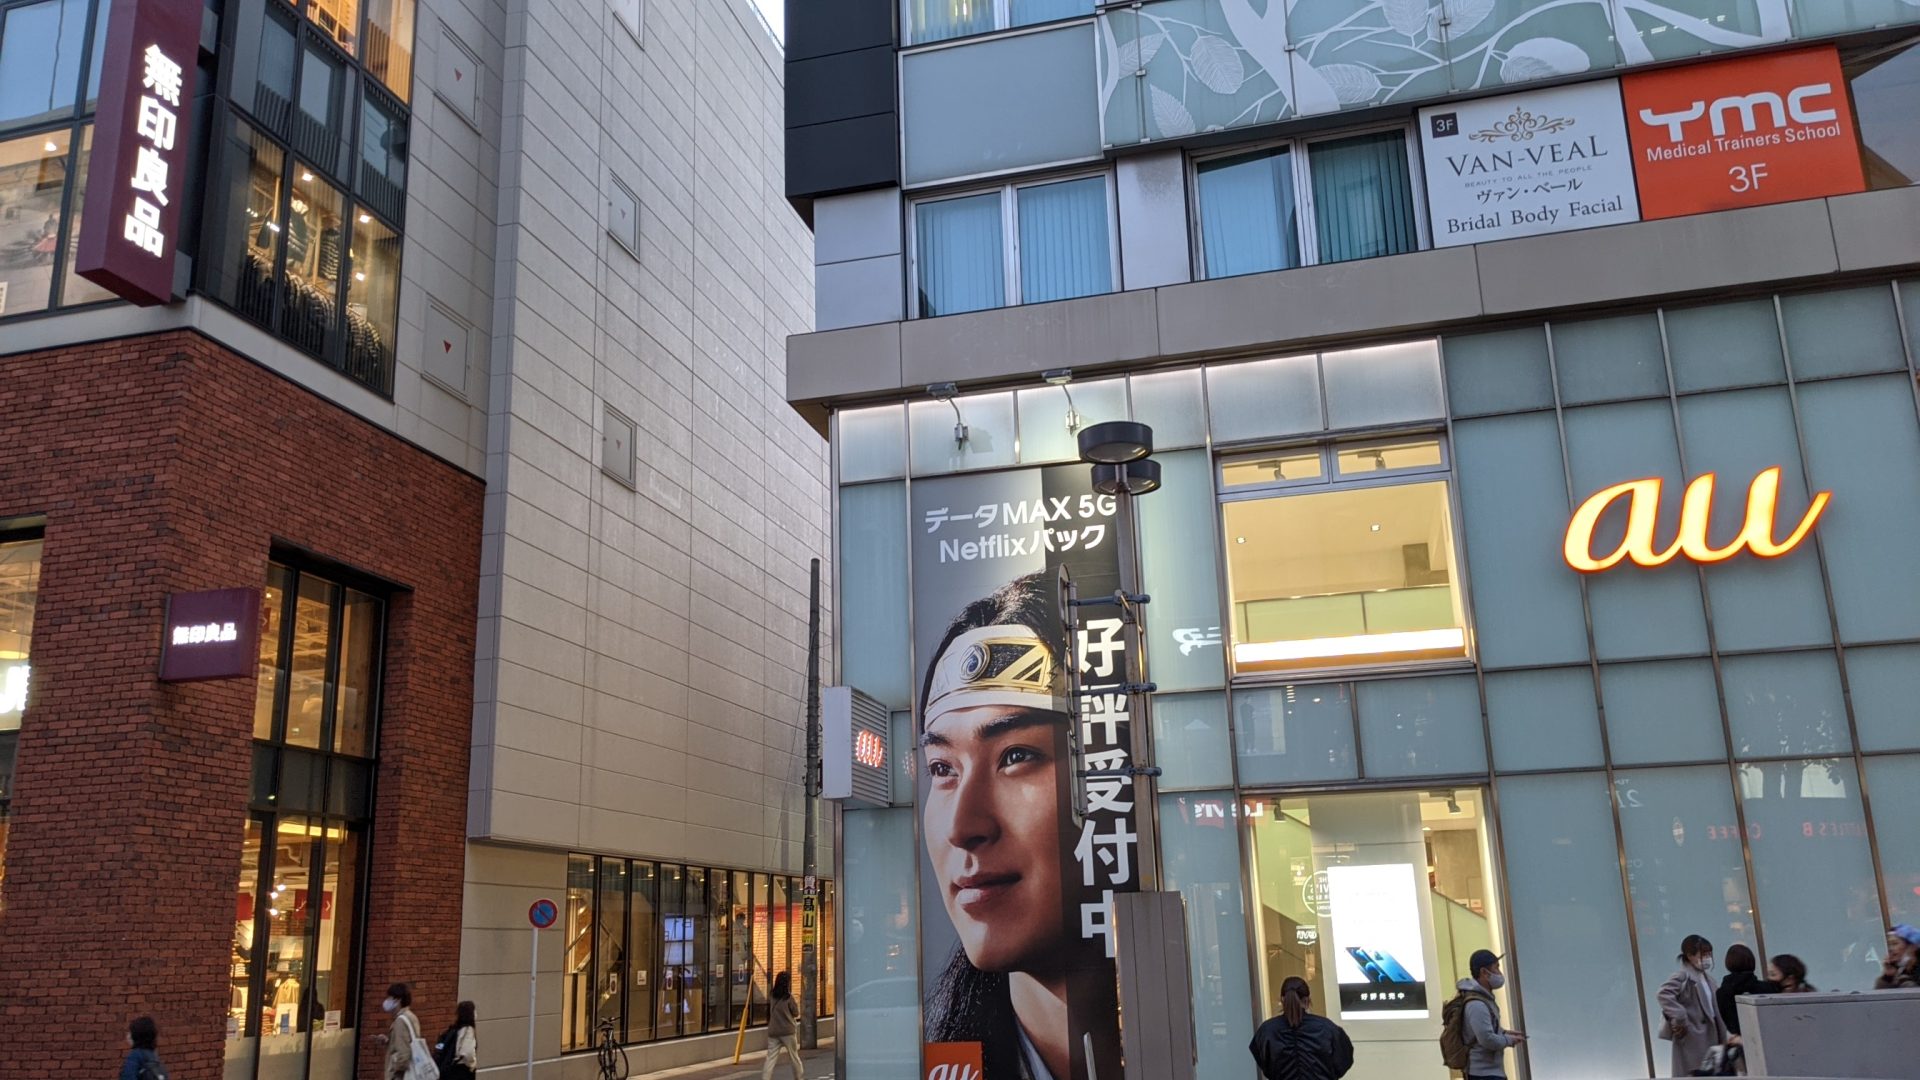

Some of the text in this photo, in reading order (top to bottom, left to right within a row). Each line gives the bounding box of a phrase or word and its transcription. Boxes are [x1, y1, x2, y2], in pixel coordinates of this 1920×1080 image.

[1436, 119, 1454, 133] 3F
[1646, 123, 1841, 162] Medical Trainers School
[124, 44, 182, 258] 無印良品
[1446, 135, 1608, 177] VAN-VEAL
[1464, 178, 1498, 188] BEAUTY
[1558, 165, 1593, 175] PEOPLE
[1728, 163, 1768, 193] 3F
[1447, 195, 1624, 234] Bridal Body Facial
[925, 494, 1117, 534] データMAX 5G
[1563, 464, 1833, 574] au
[939, 524, 1106, 563] Netflixパック
[172, 622, 237, 646] 無印良品
